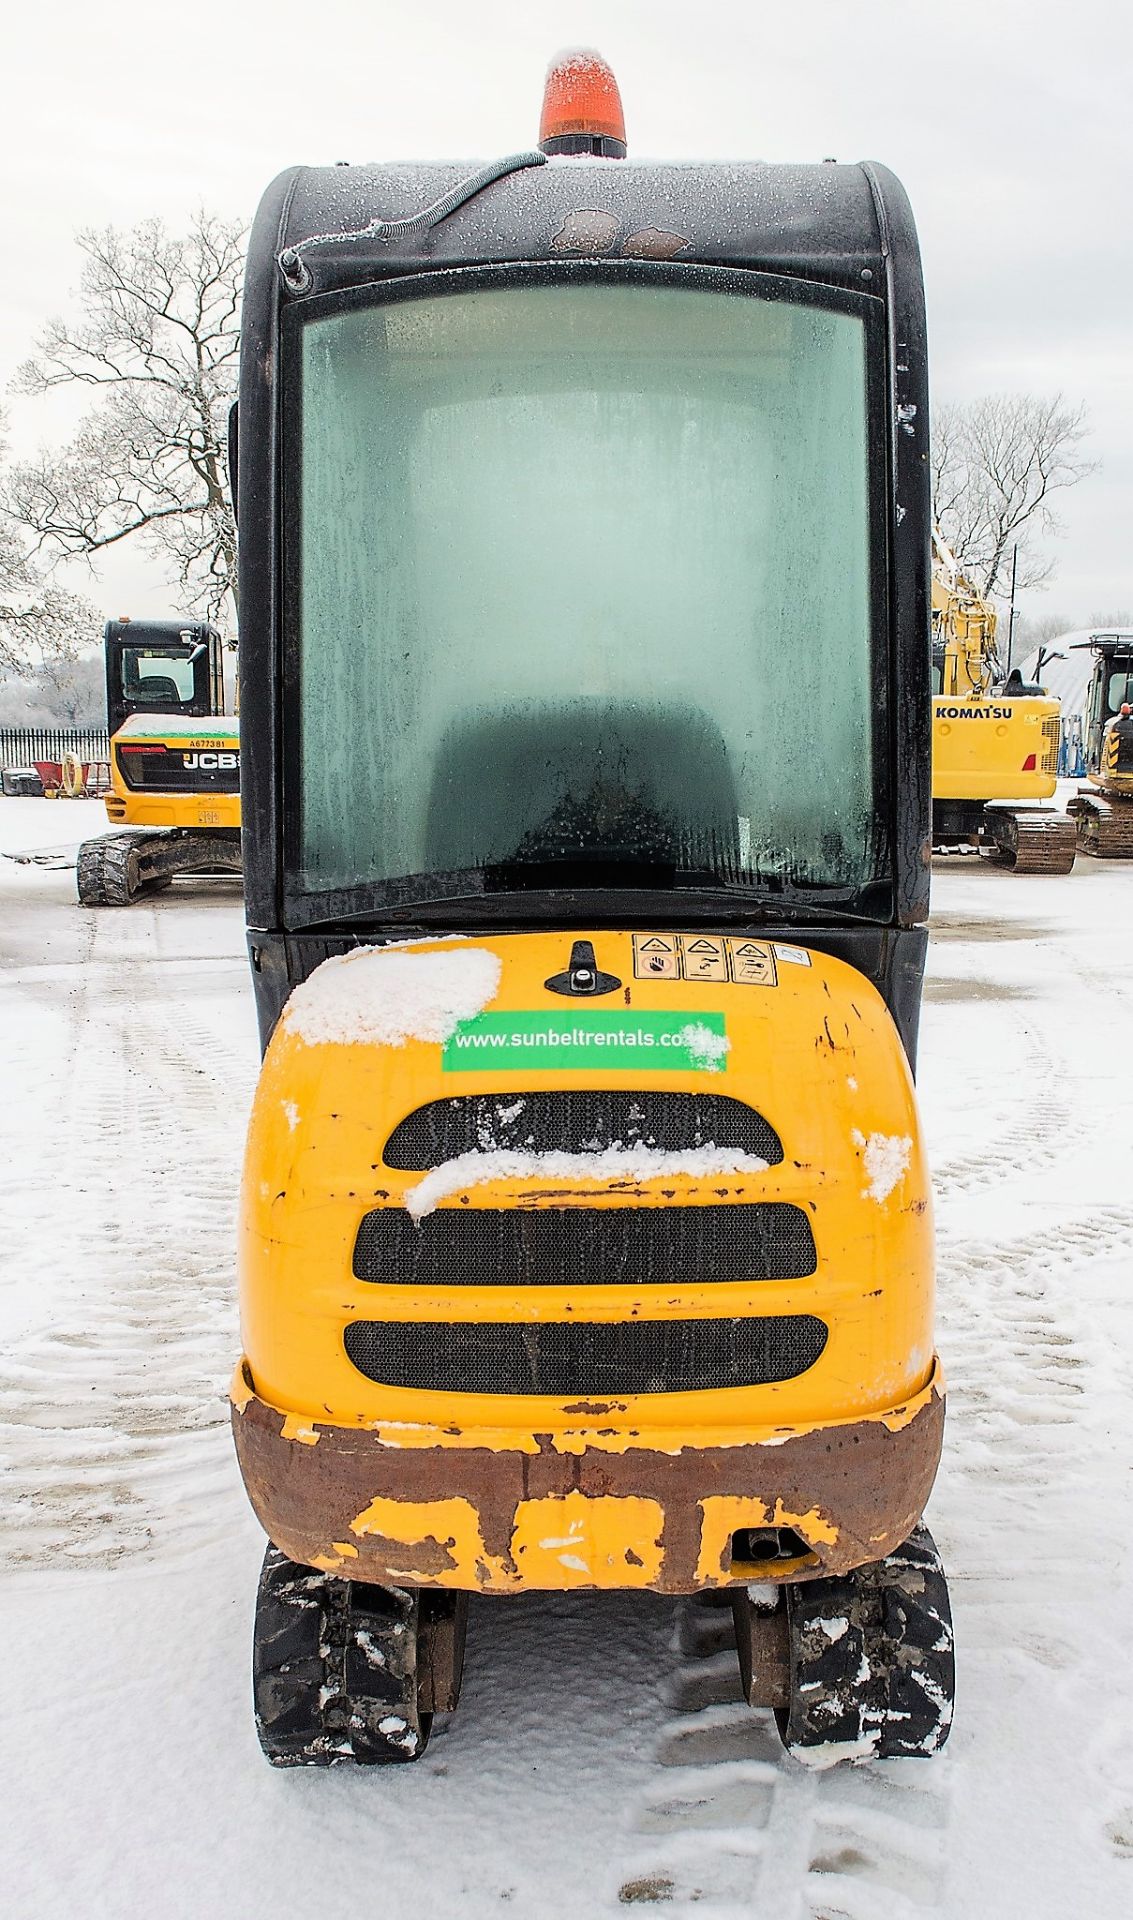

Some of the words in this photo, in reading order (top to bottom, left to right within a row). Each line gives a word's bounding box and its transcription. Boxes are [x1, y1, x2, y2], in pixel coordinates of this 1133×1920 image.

[936, 704, 1012, 719] KOMATSU
[190, 740, 225, 748] A677381
[183, 753, 237, 769] JCB
[455, 1029, 706, 1048] www.sunbeltrentals.co
